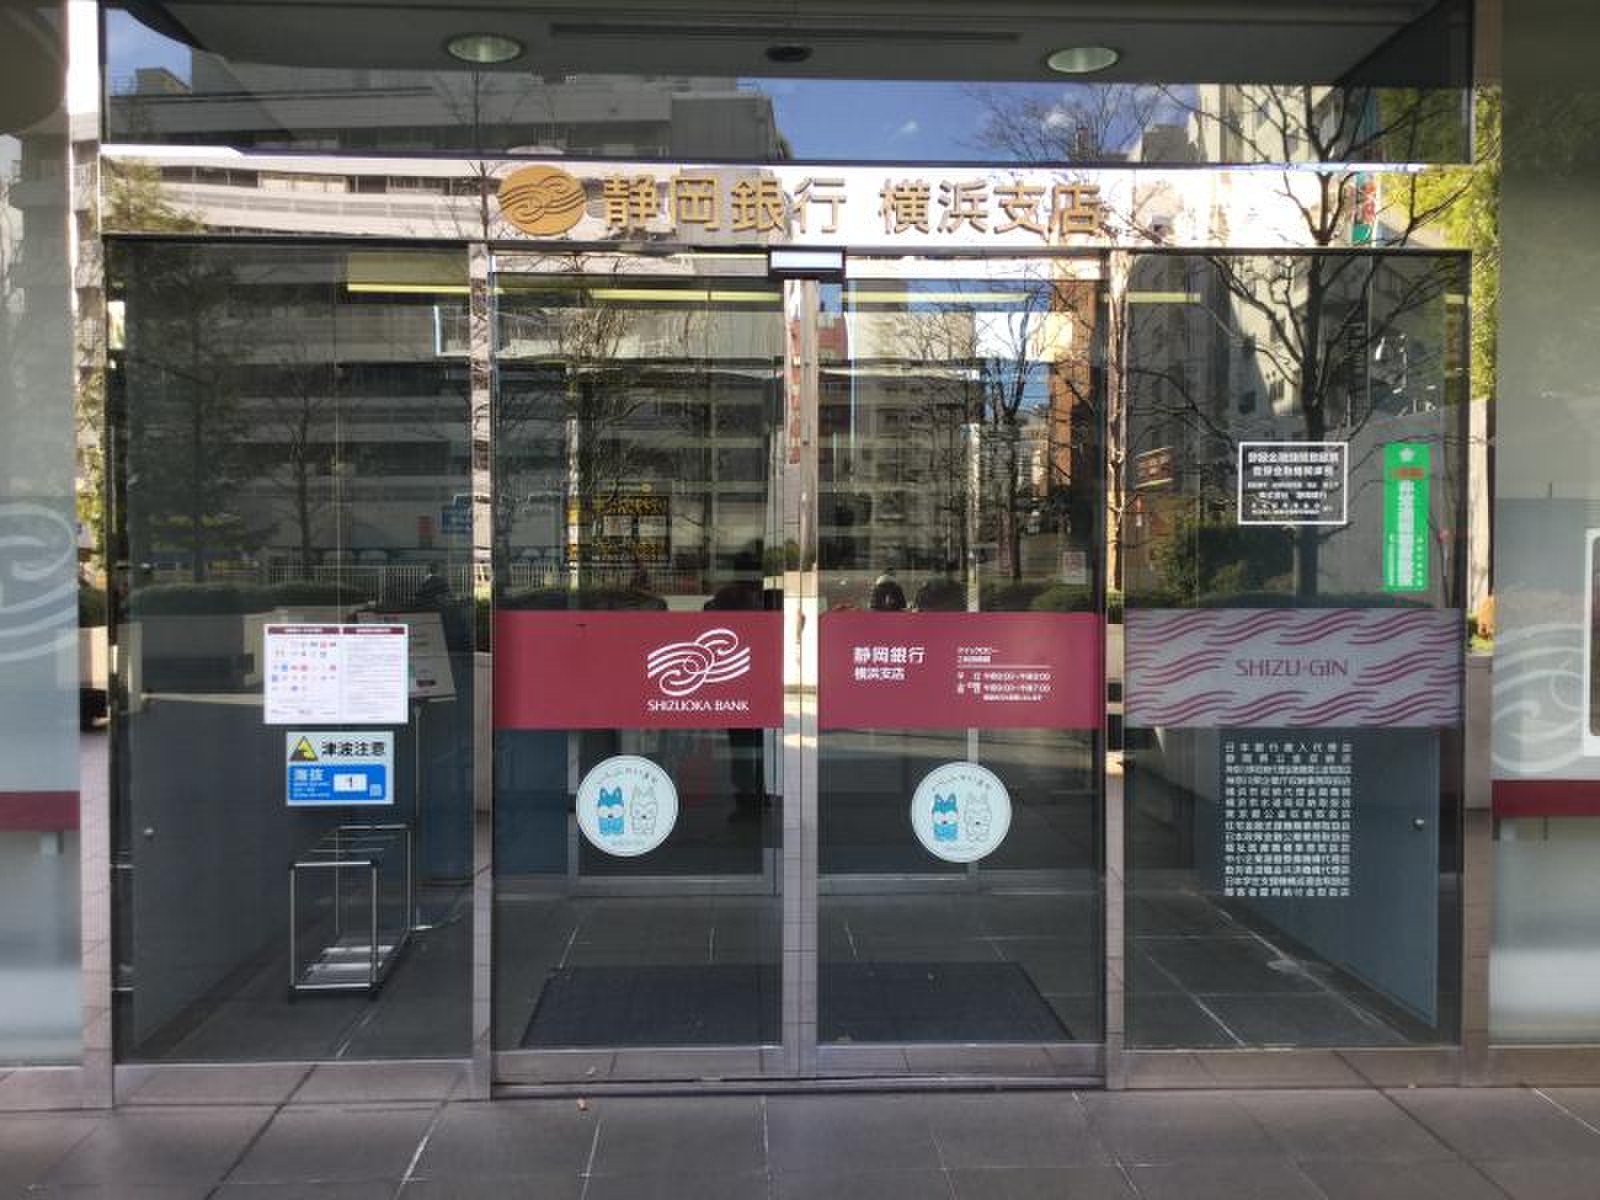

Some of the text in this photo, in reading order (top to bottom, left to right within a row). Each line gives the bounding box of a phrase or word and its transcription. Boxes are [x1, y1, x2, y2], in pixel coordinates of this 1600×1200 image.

[602, 174, 1106, 236] 静岡銀行 横浜支店
[853, 646, 926, 664] 静岡銀行
[854, 667, 906, 681] 横浜支店
[647, 700, 750, 711] SHIZUOKA BANK
[321, 740, 385, 757] 津波注意
